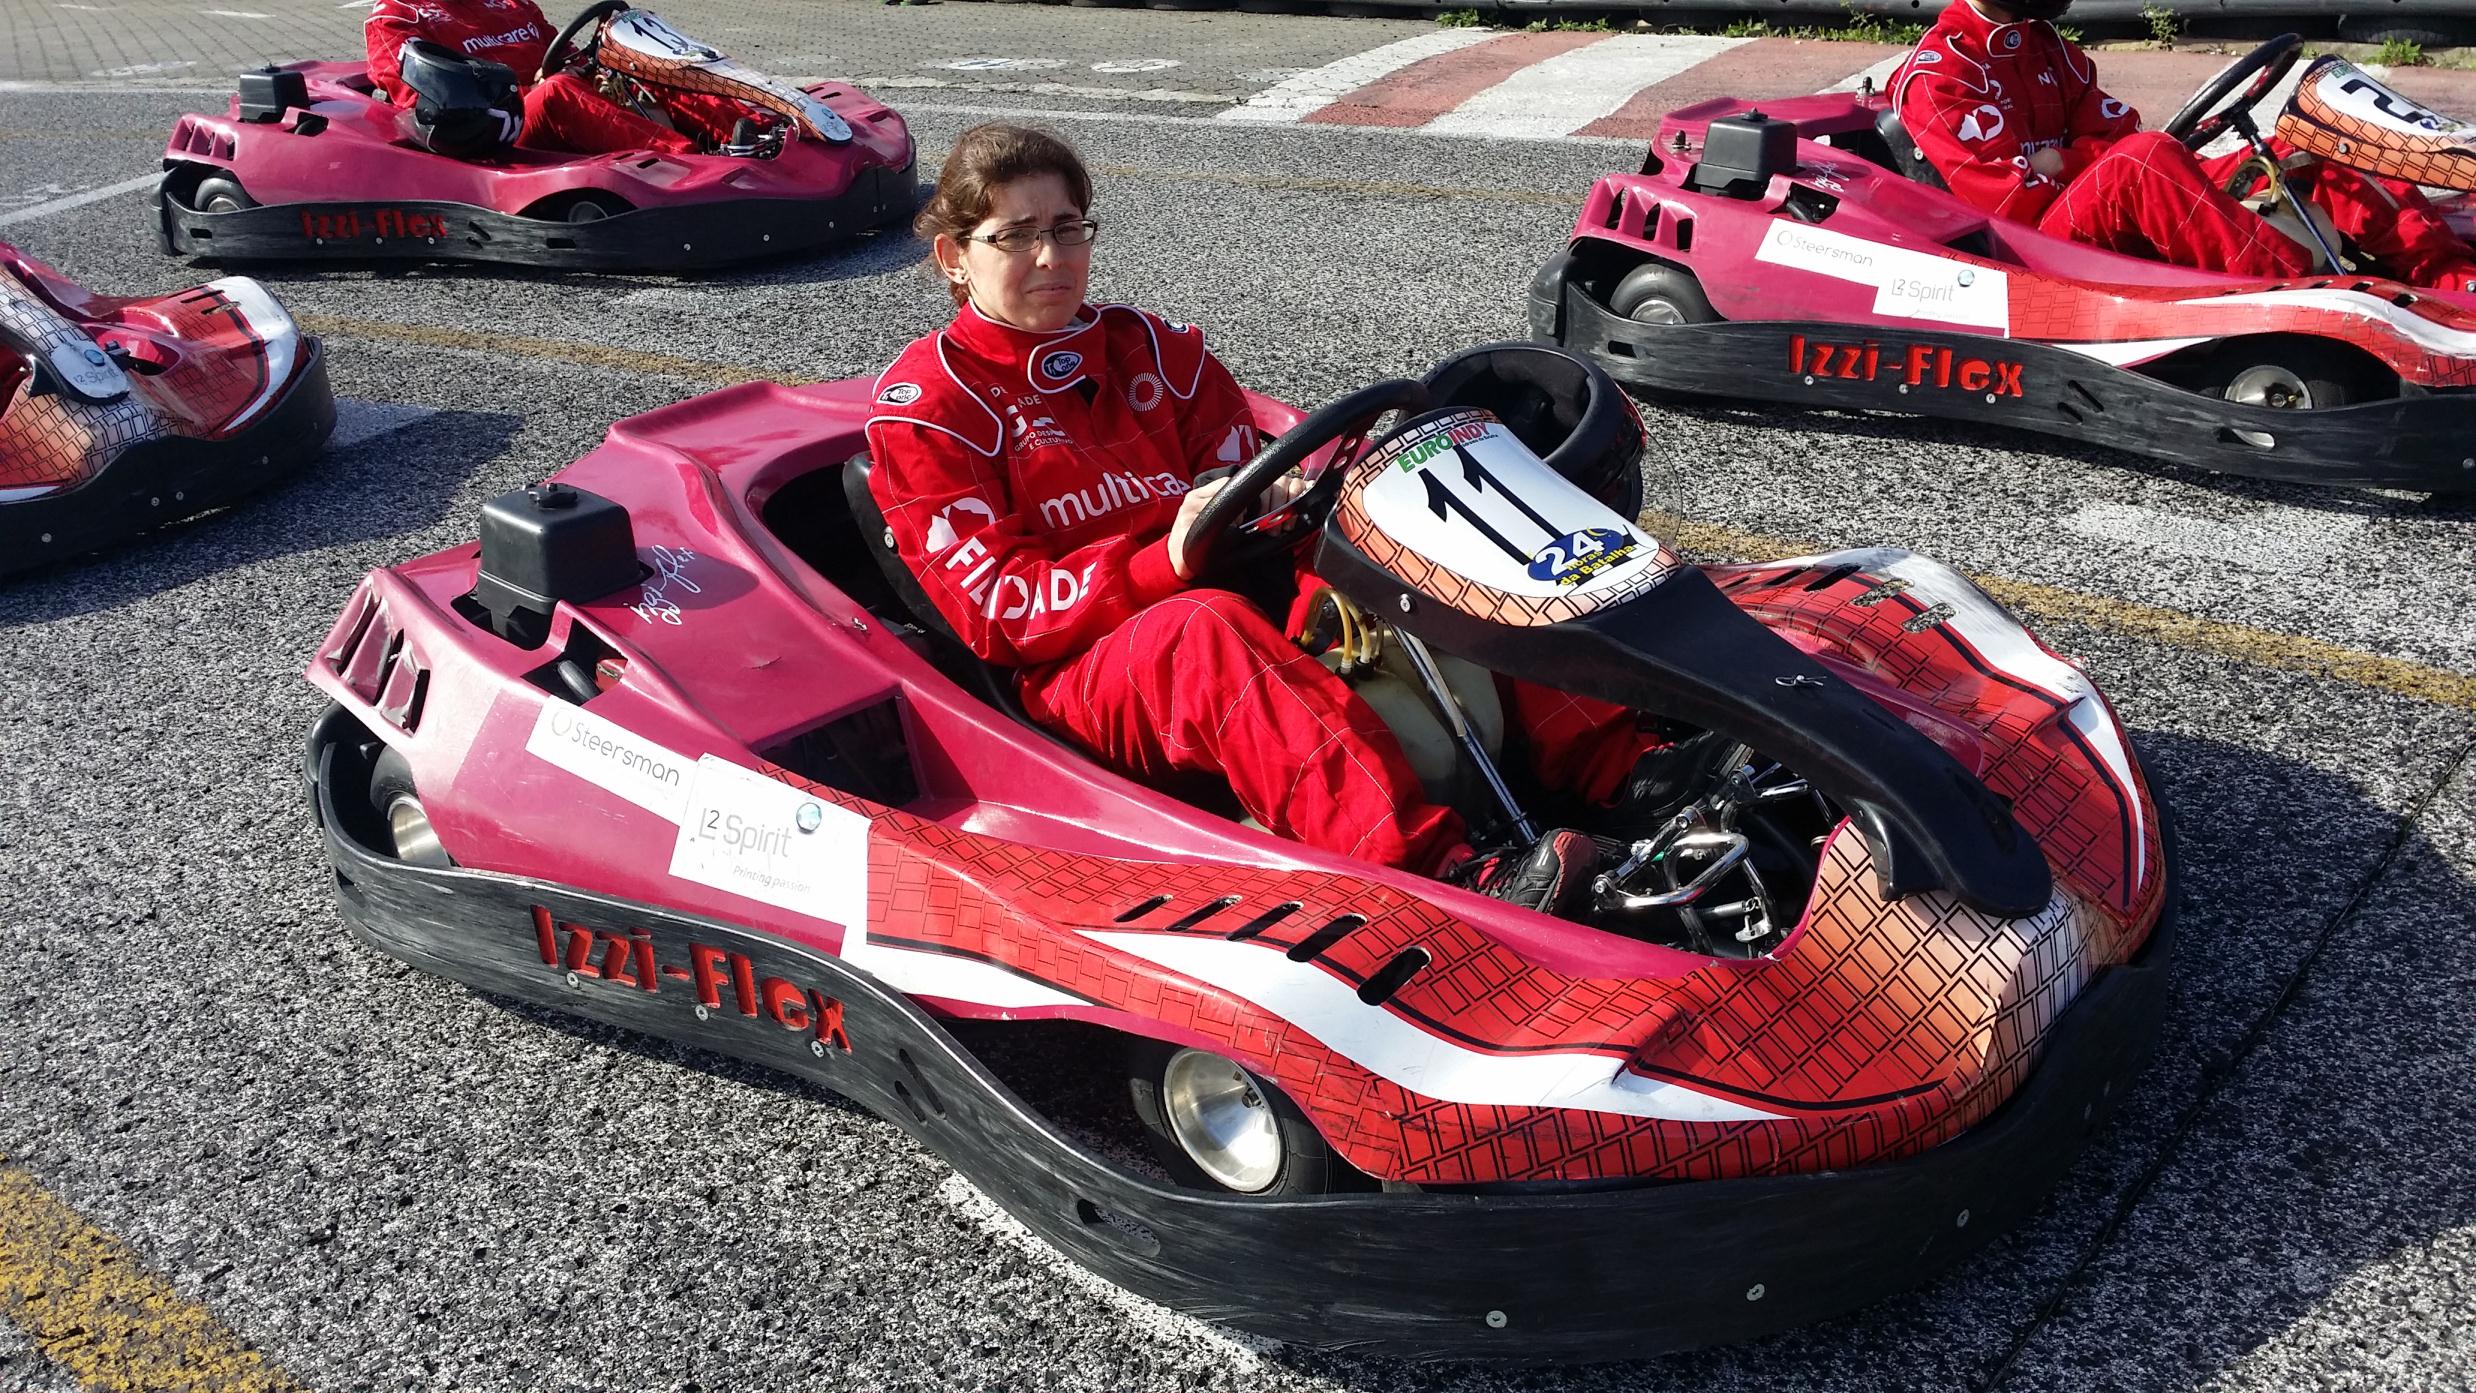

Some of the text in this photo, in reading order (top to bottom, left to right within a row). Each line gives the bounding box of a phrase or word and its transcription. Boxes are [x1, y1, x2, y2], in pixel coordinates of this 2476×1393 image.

[462, 28, 530, 54] multicare
[1792, 236, 1874, 267] Steersman
[1907, 280, 1955, 302] Spirit
[1788, 334, 2024, 398] Izzi-Flex
[1014, 431, 1036, 452] GRUPO
[1397, 422, 1490, 474] EUROINDY
[1417, 443, 1563, 567] 11
[1535, 531, 1605, 577] 24
[1560, 545, 1634, 586] da Batalha
[571, 722, 681, 787] Steersman
[723, 814, 792, 858] Spirit
[530, 904, 852, 1054] Izzi-Flex
